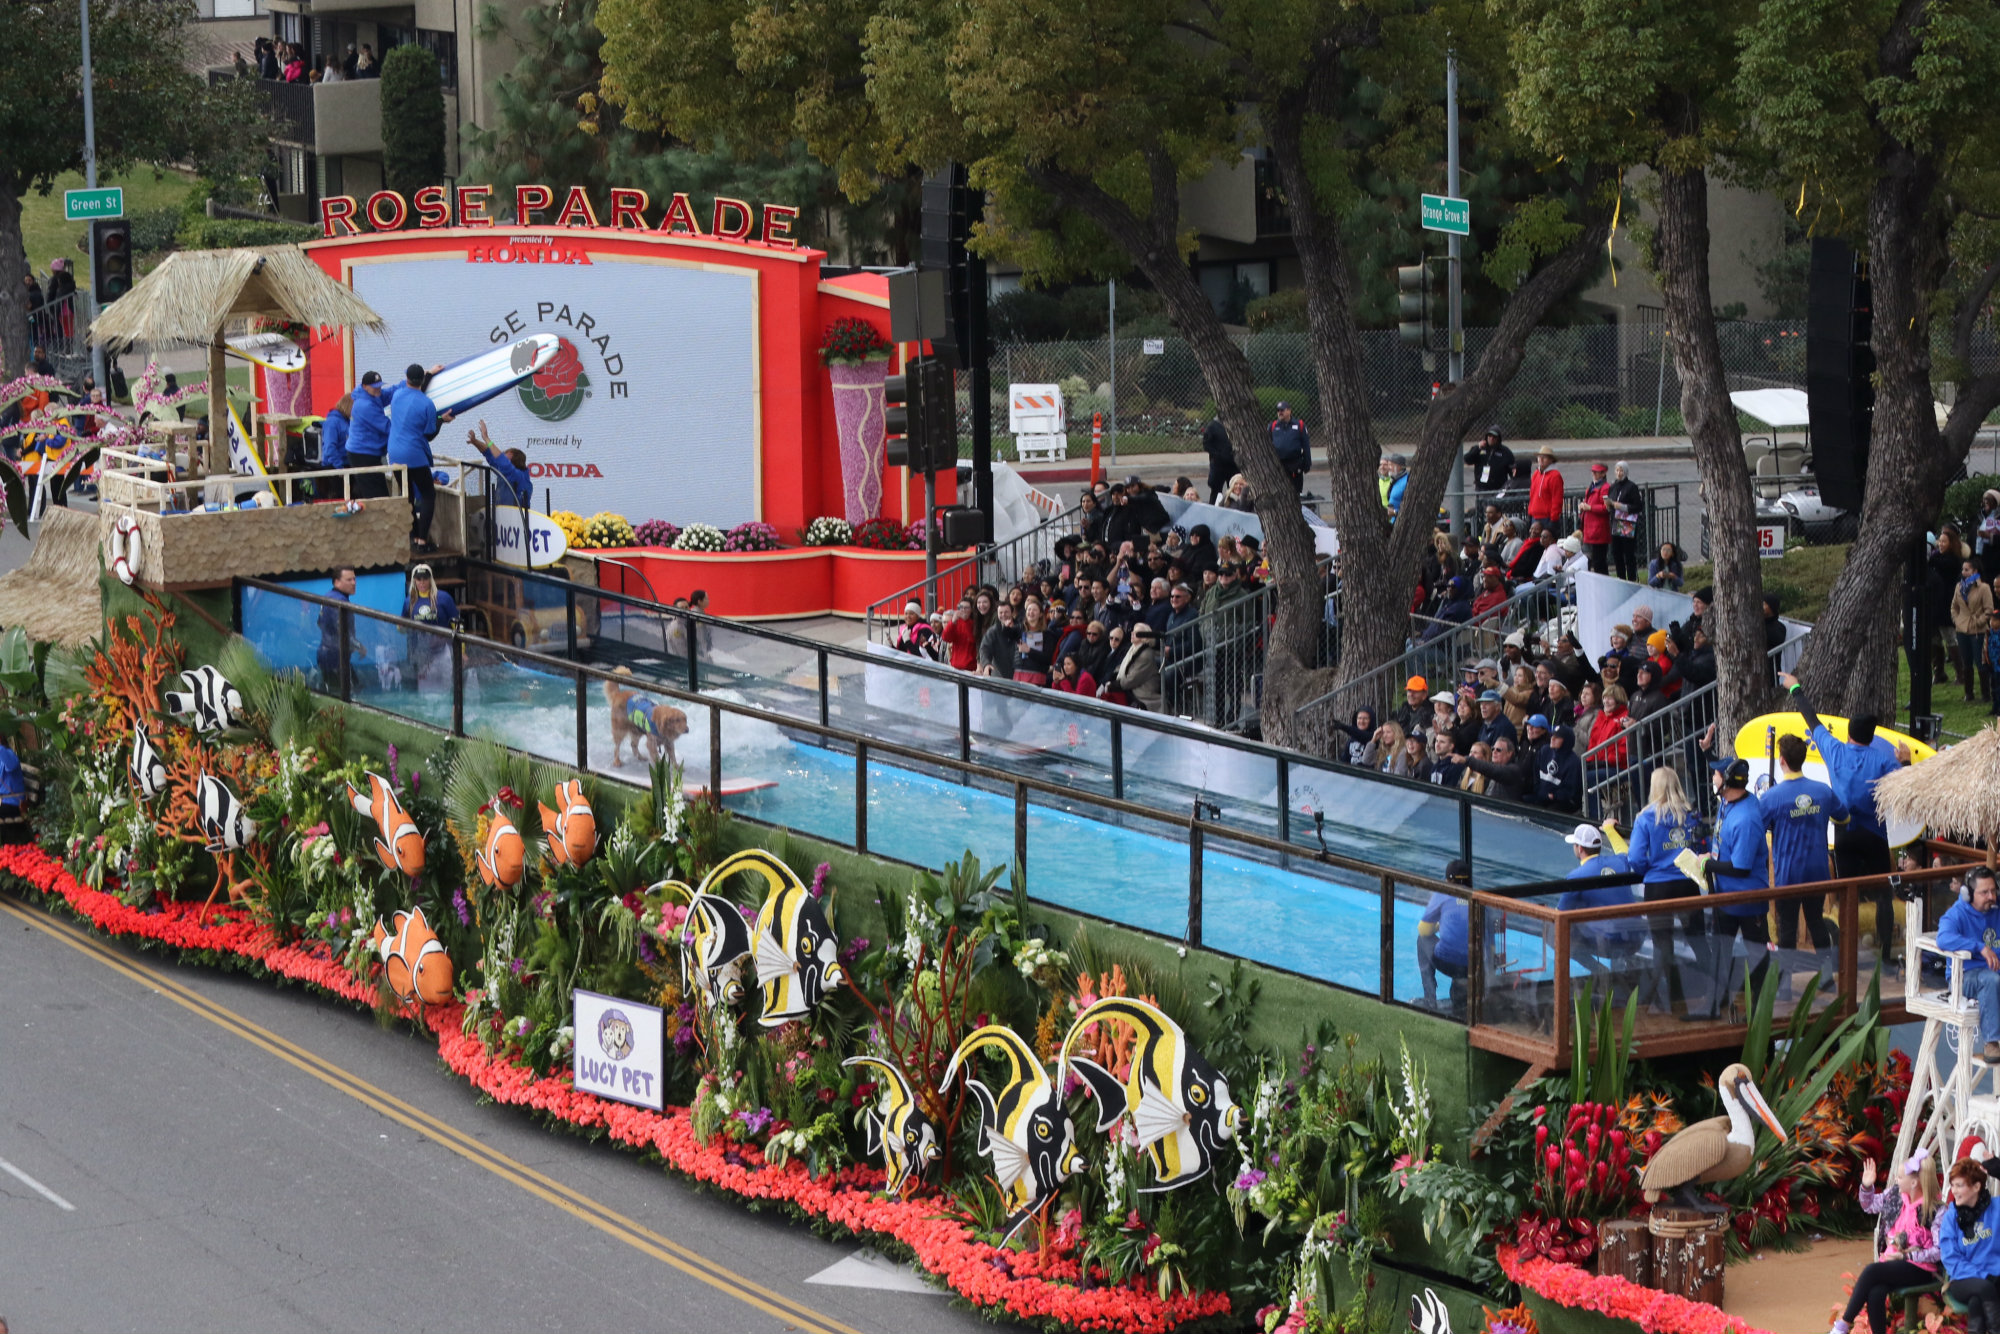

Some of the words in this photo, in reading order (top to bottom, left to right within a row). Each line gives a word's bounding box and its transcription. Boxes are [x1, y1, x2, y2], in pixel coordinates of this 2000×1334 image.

[71, 198, 101, 211] Green
[105, 196, 117, 209] St
[320, 184, 494, 237] ROSE
[516, 184, 800, 251] PARADE
[1423, 204, 1443, 224] Orange
[1444, 207, 1461, 224] Grove
[508, 235, 543, 246] presented
[544, 234, 554, 247] by
[465, 245, 594, 265] HONDA
[489, 309, 527, 344] SE
[537, 302, 629, 399] PARADE
[526, 434, 569, 448] presented
[571, 434, 583, 448] by
[527, 462, 604, 478] ONDA
[581, 1055, 617, 1087] LUCY
[622, 1066, 654, 1097] PET
